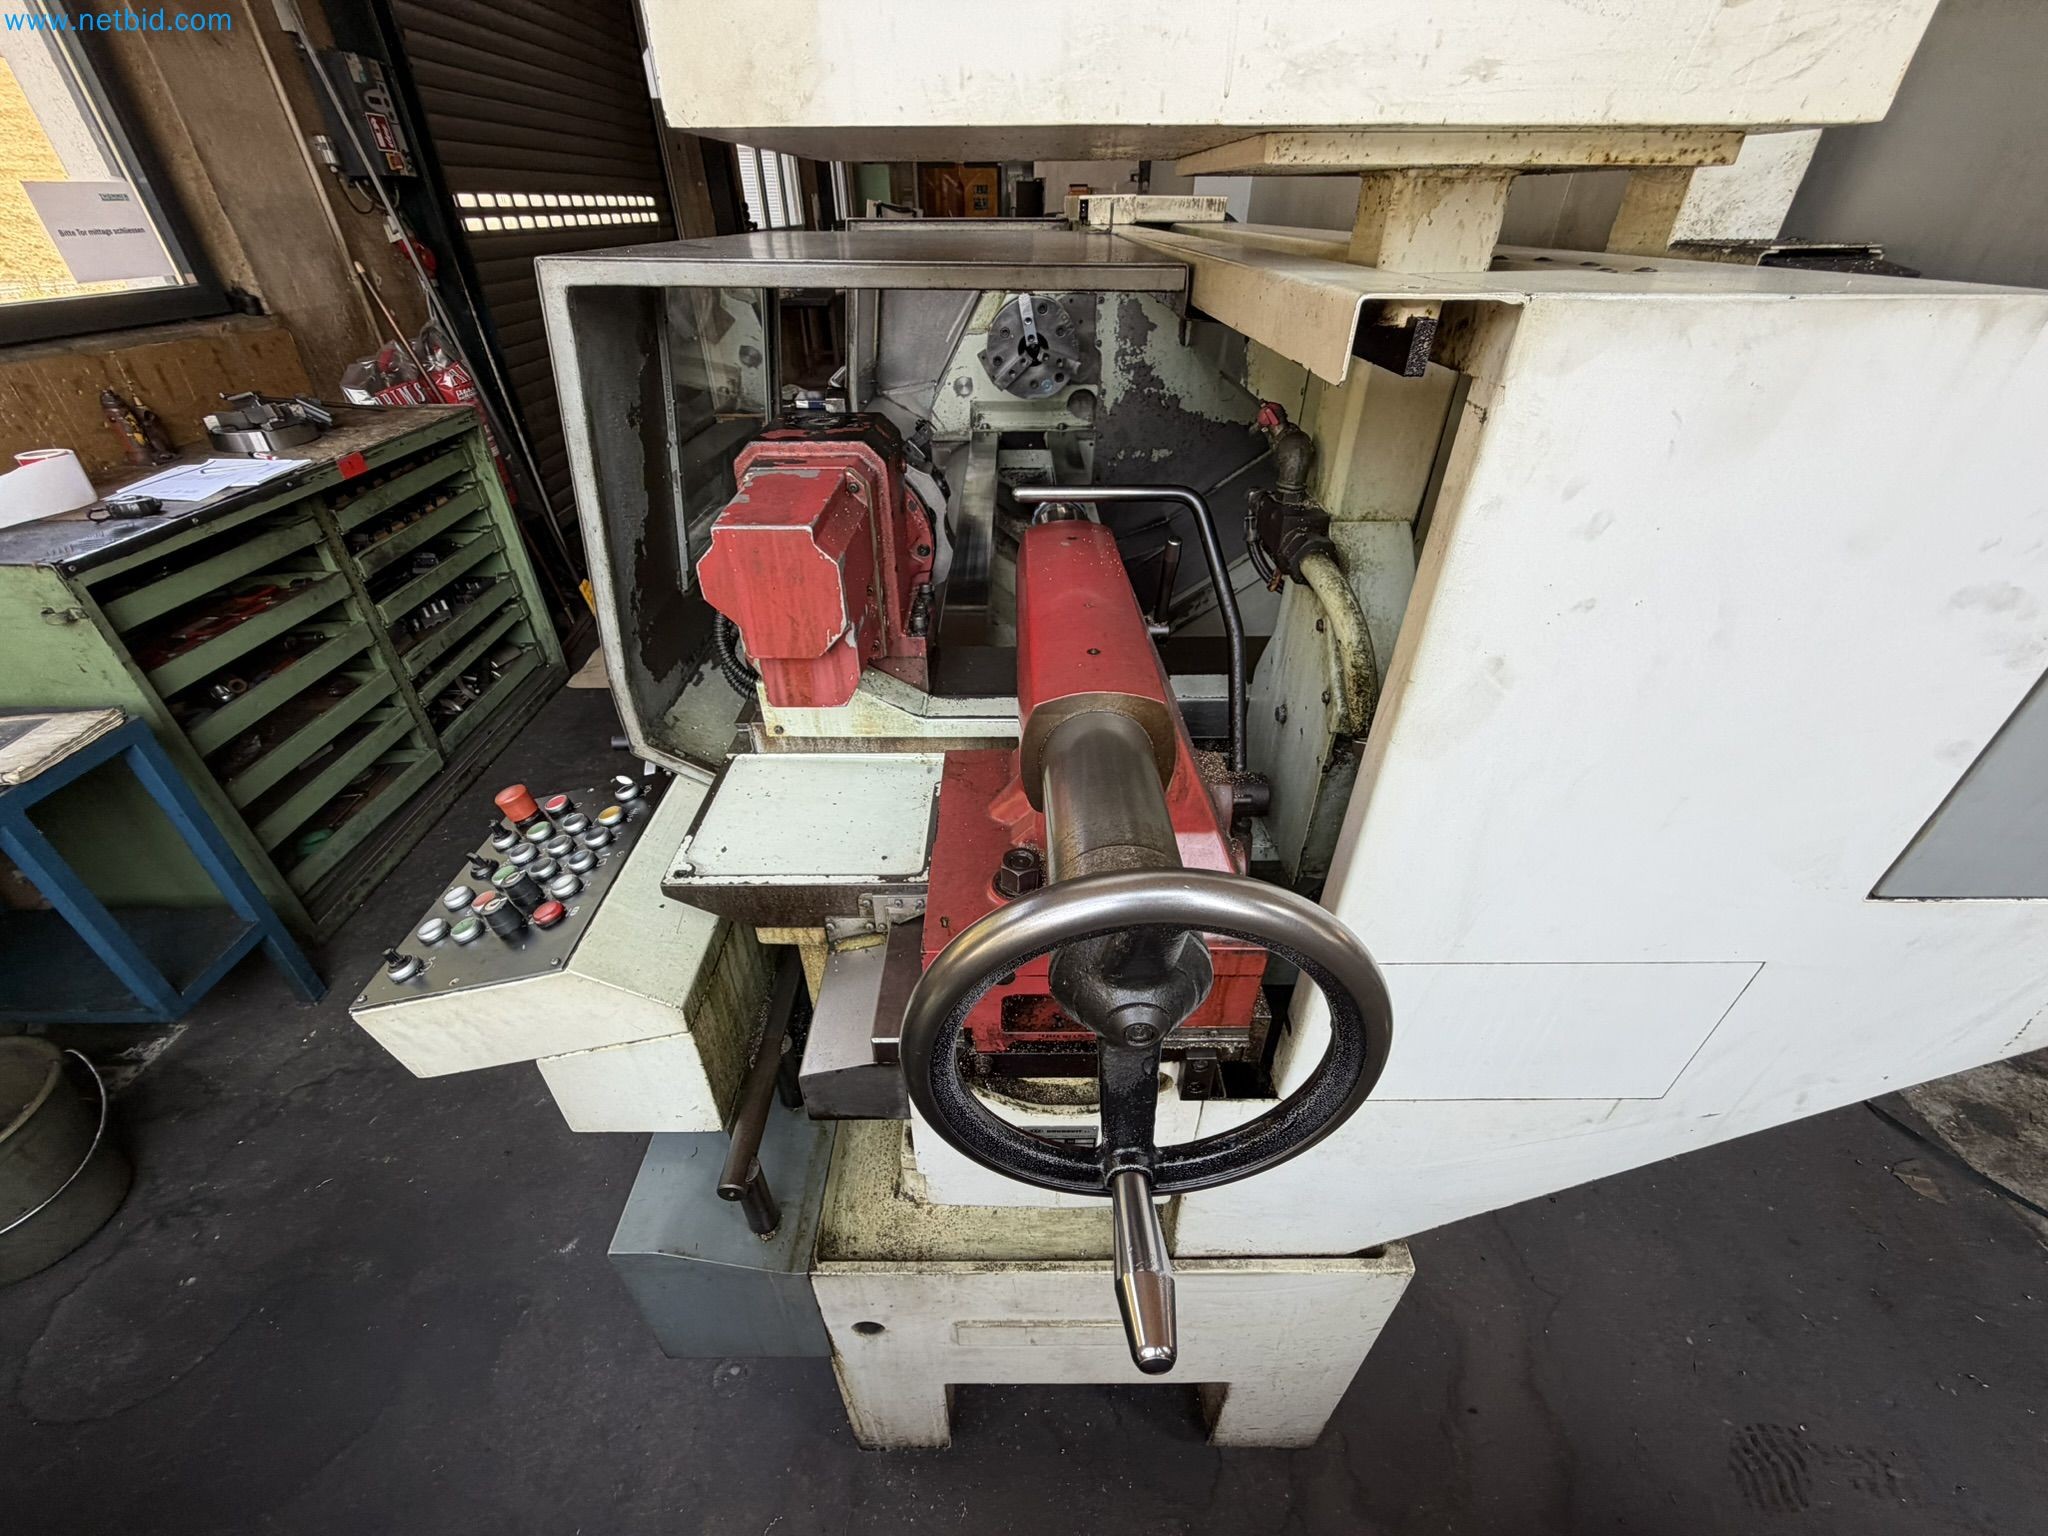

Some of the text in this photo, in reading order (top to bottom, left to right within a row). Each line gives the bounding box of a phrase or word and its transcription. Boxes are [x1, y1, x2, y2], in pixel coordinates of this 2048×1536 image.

[58, 229, 76, 237] Bitte
[76, 228, 88, 236] Tor
[89, 228, 113, 236] mittags
